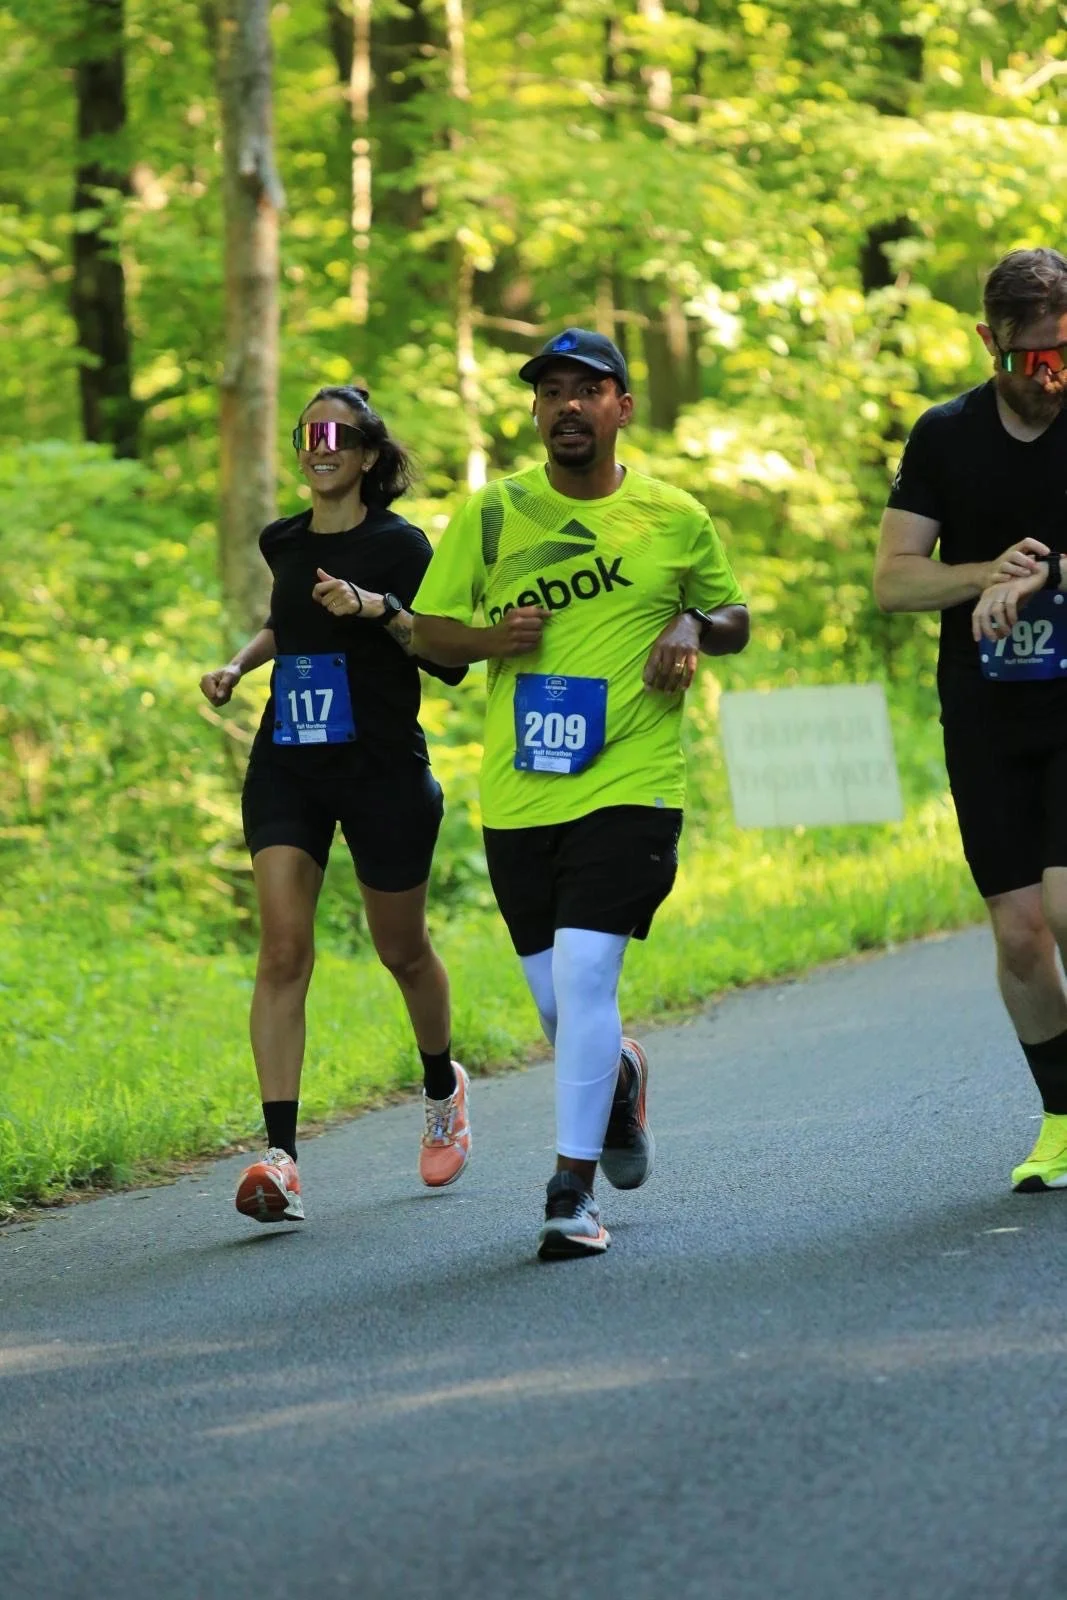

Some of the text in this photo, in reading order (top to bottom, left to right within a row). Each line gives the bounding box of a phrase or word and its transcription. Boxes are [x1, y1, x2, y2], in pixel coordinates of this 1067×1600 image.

[288, 688, 334, 722] 117
[524, 711, 587, 750] 209
[533, 748, 573, 758] Half Marathon
